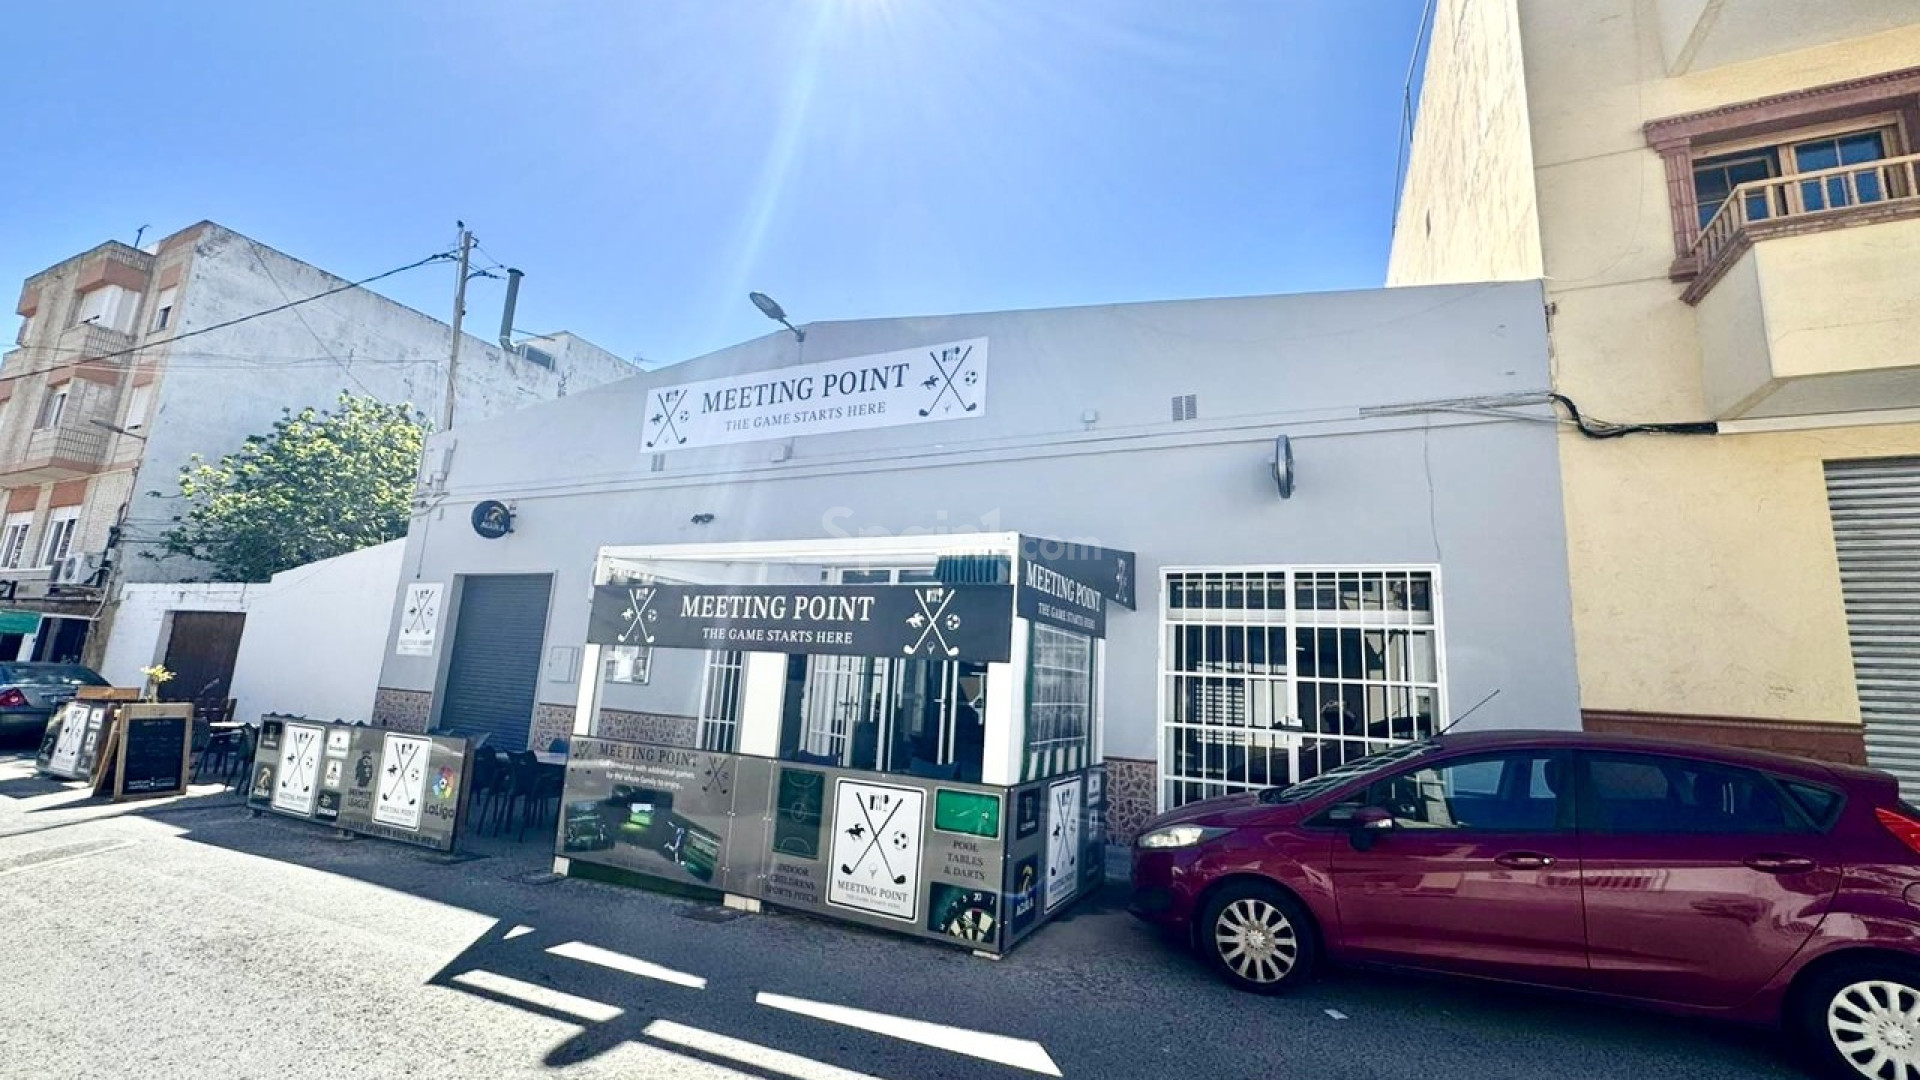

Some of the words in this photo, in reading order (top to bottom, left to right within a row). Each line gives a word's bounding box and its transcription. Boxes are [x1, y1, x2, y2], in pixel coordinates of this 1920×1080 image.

[702, 377, 813, 414] MEETING
[821, 363, 910, 397] POINT
[725, 419, 750, 432] THE
[753, 414, 791, 429] GAME
[793, 407, 844, 424] STARTS
[847, 402, 886, 417] HERE
[1025, 560, 1075, 602] MEETING
[1076, 581, 1101, 612] POINT
[680, 595, 787, 619] MEETING
[793, 596, 875, 622] POINT
[703, 627, 725, 640] THE
[728, 628, 763, 642] GAME
[766, 629, 813, 643] STARTS
[816, 631, 853, 644] HERE
[599, 742, 655, 762] MEETING
[658, 749, 697, 767] POINT
[953, 840, 979, 852] POOL
[947, 853, 983, 867] TABLES
[953, 867, 985, 881] DARTS
[838, 879, 876, 897] MEETING
[878, 887, 909, 903] POINT
